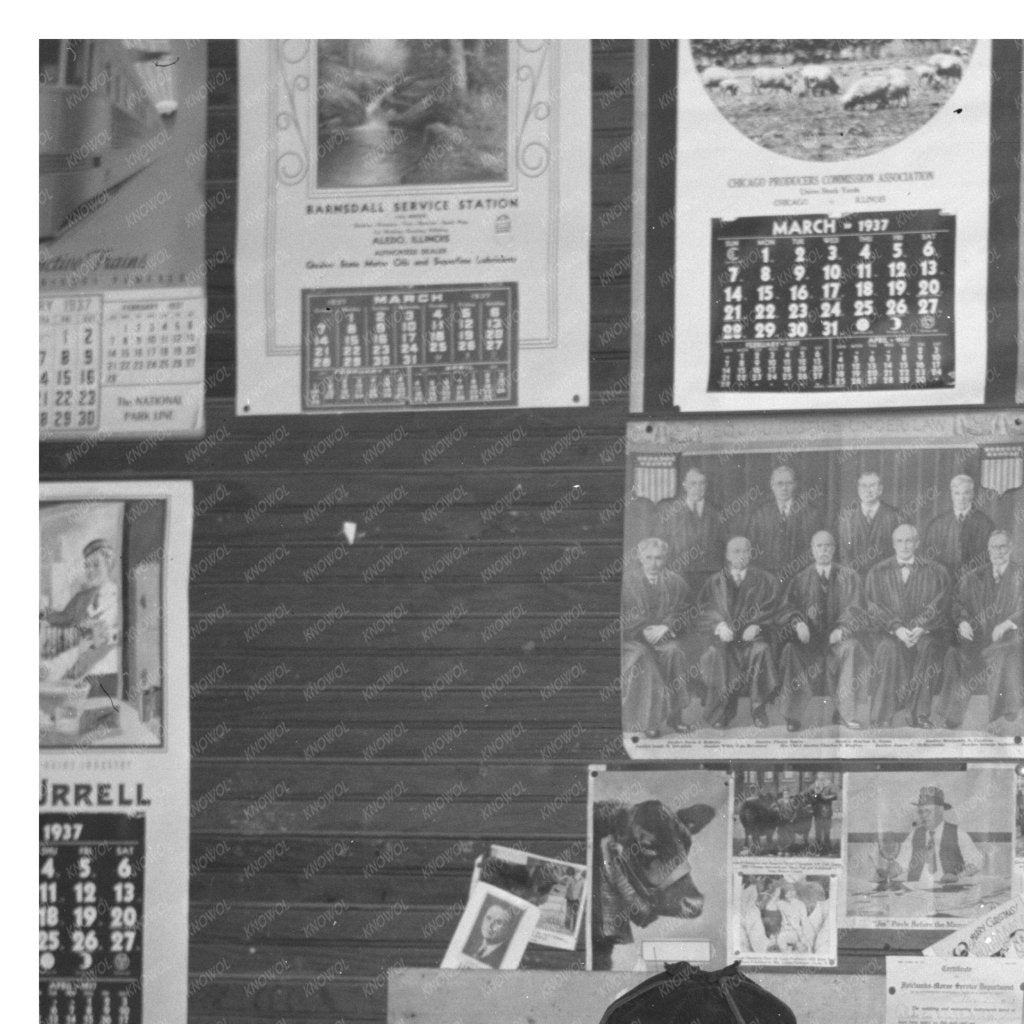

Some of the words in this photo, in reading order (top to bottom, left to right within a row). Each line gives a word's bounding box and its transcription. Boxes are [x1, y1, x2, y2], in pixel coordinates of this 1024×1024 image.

[728, 178, 765, 188] CHICAGO
[769, 176, 818, 186] PRODUCERS
[823, 174, 874, 184] COMMISSION
[879, 171, 934, 182] ASSOCIATION
[306, 204, 383, 214] BARNSDALL
[394, 201, 449, 212] SERVICE
[459, 198, 518, 210] STATION
[773, 219, 836, 235] MARCH
[859, 219, 889, 231] 1937
[762, 247, 769, 262] 1
[795, 247, 805, 262] 2
[828, 245, 837, 260] 3
[860, 244, 871, 259] 4
[893, 243, 902, 258] 5
[923, 241, 934, 256] 6
[729, 267, 739, 282] 7
[761, 266, 770, 281] 8
[794, 265, 805, 281] 9
[823, 264, 841, 280] 10
[857, 263, 871, 278] 11
[889, 262, 906, 277] 12
[920, 260, 937, 275] 13
[64, 299, 91, 311] 1937
[374, 294, 442, 303] MARCH
[44, 824, 82, 840] 1937
[41, 858, 55, 878] 4
[78, 858, 91, 878] 5
[117, 857, 131, 878] 6
[39, 882, 57, 903] 11
[73, 882, 96, 903] 12
[114, 882, 135, 903] 13
[39, 907, 59, 927] 18
[73, 907, 97, 927] 19
[110, 907, 137, 928] 20
